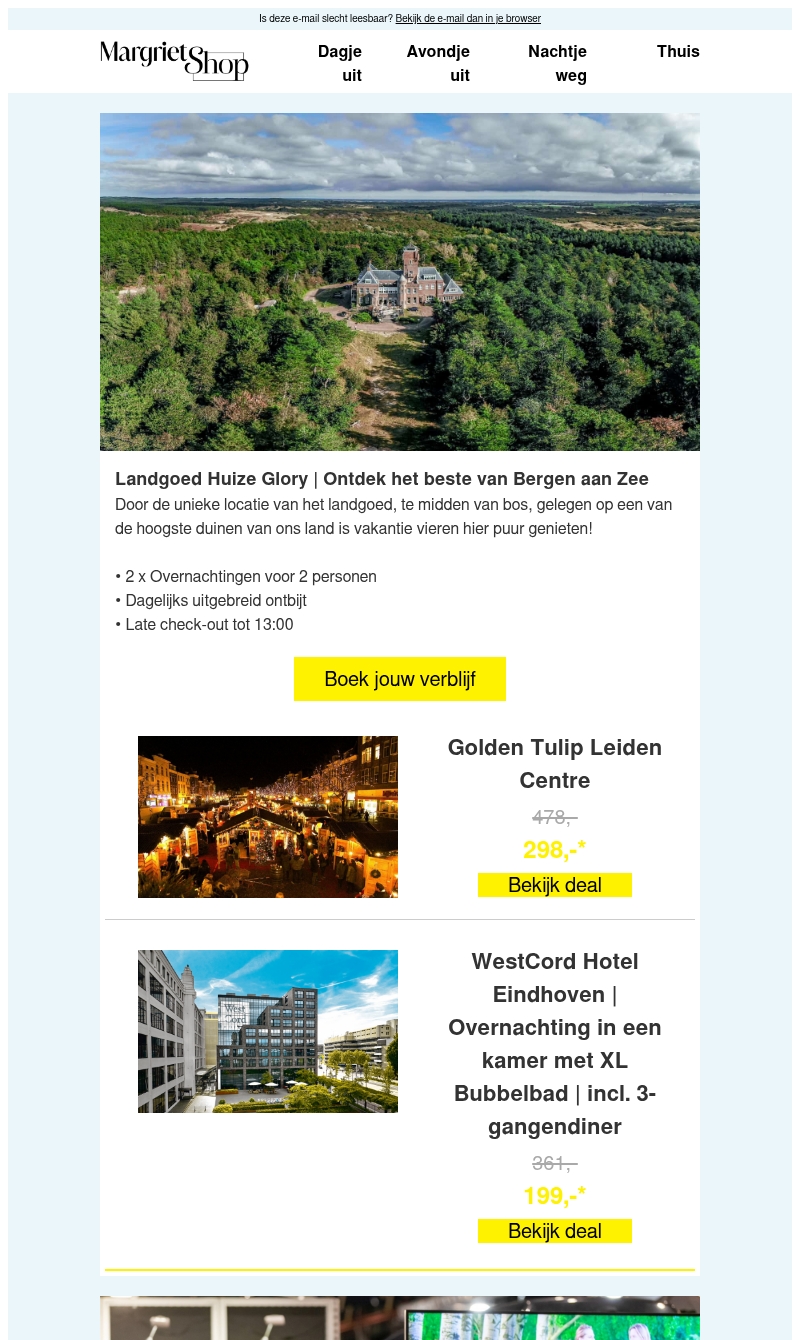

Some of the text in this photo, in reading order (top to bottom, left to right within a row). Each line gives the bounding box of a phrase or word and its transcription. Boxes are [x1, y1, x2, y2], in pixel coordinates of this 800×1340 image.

[260, 14, 541, 24] Is deze e-mail slecht leesbaar? Bekijk de e-mail dan in je browser
[319, 45, 362, 61] Dagje
[407, 45, 470, 61] Avondje
[529, 45, 587, 61] Nachtje
[657, 45, 700, 57] Thuis
[101, 41, 249, 81] Margriet Shop
[343, 69, 362, 81] uit
[451, 69, 470, 81] uit
[556, 72, 586, 85] weg
[116, 472, 648, 489] Landgoed Huize Glory Ontdek het beste van Bergen aan Zee
[126, 570, 376, 585] 2 x Overnachtingen voor 2 personen
[127, 594, 307, 609] Dagelijks uitgebreid ontbijt
[326, 670, 476, 691] Boek jouw verblijf
[448, 739, 661, 760] Golden Tulip Leiden
[520, 772, 590, 788] Centre
[509, 876, 601, 896] Bekijk deal
[472, 953, 637, 969] WestCord Hotel
[494, 986, 604, 1002] Eindhoven
[449, 1019, 661, 1040] Overnachting in een
[483, 1052, 628, 1069] kamer met XL
[455, 1085, 656, 1102] Bubbelbad incl. 3-
[489, 1118, 622, 1139] gangendiner
[509, 1222, 601, 1242] Bekijk deal
